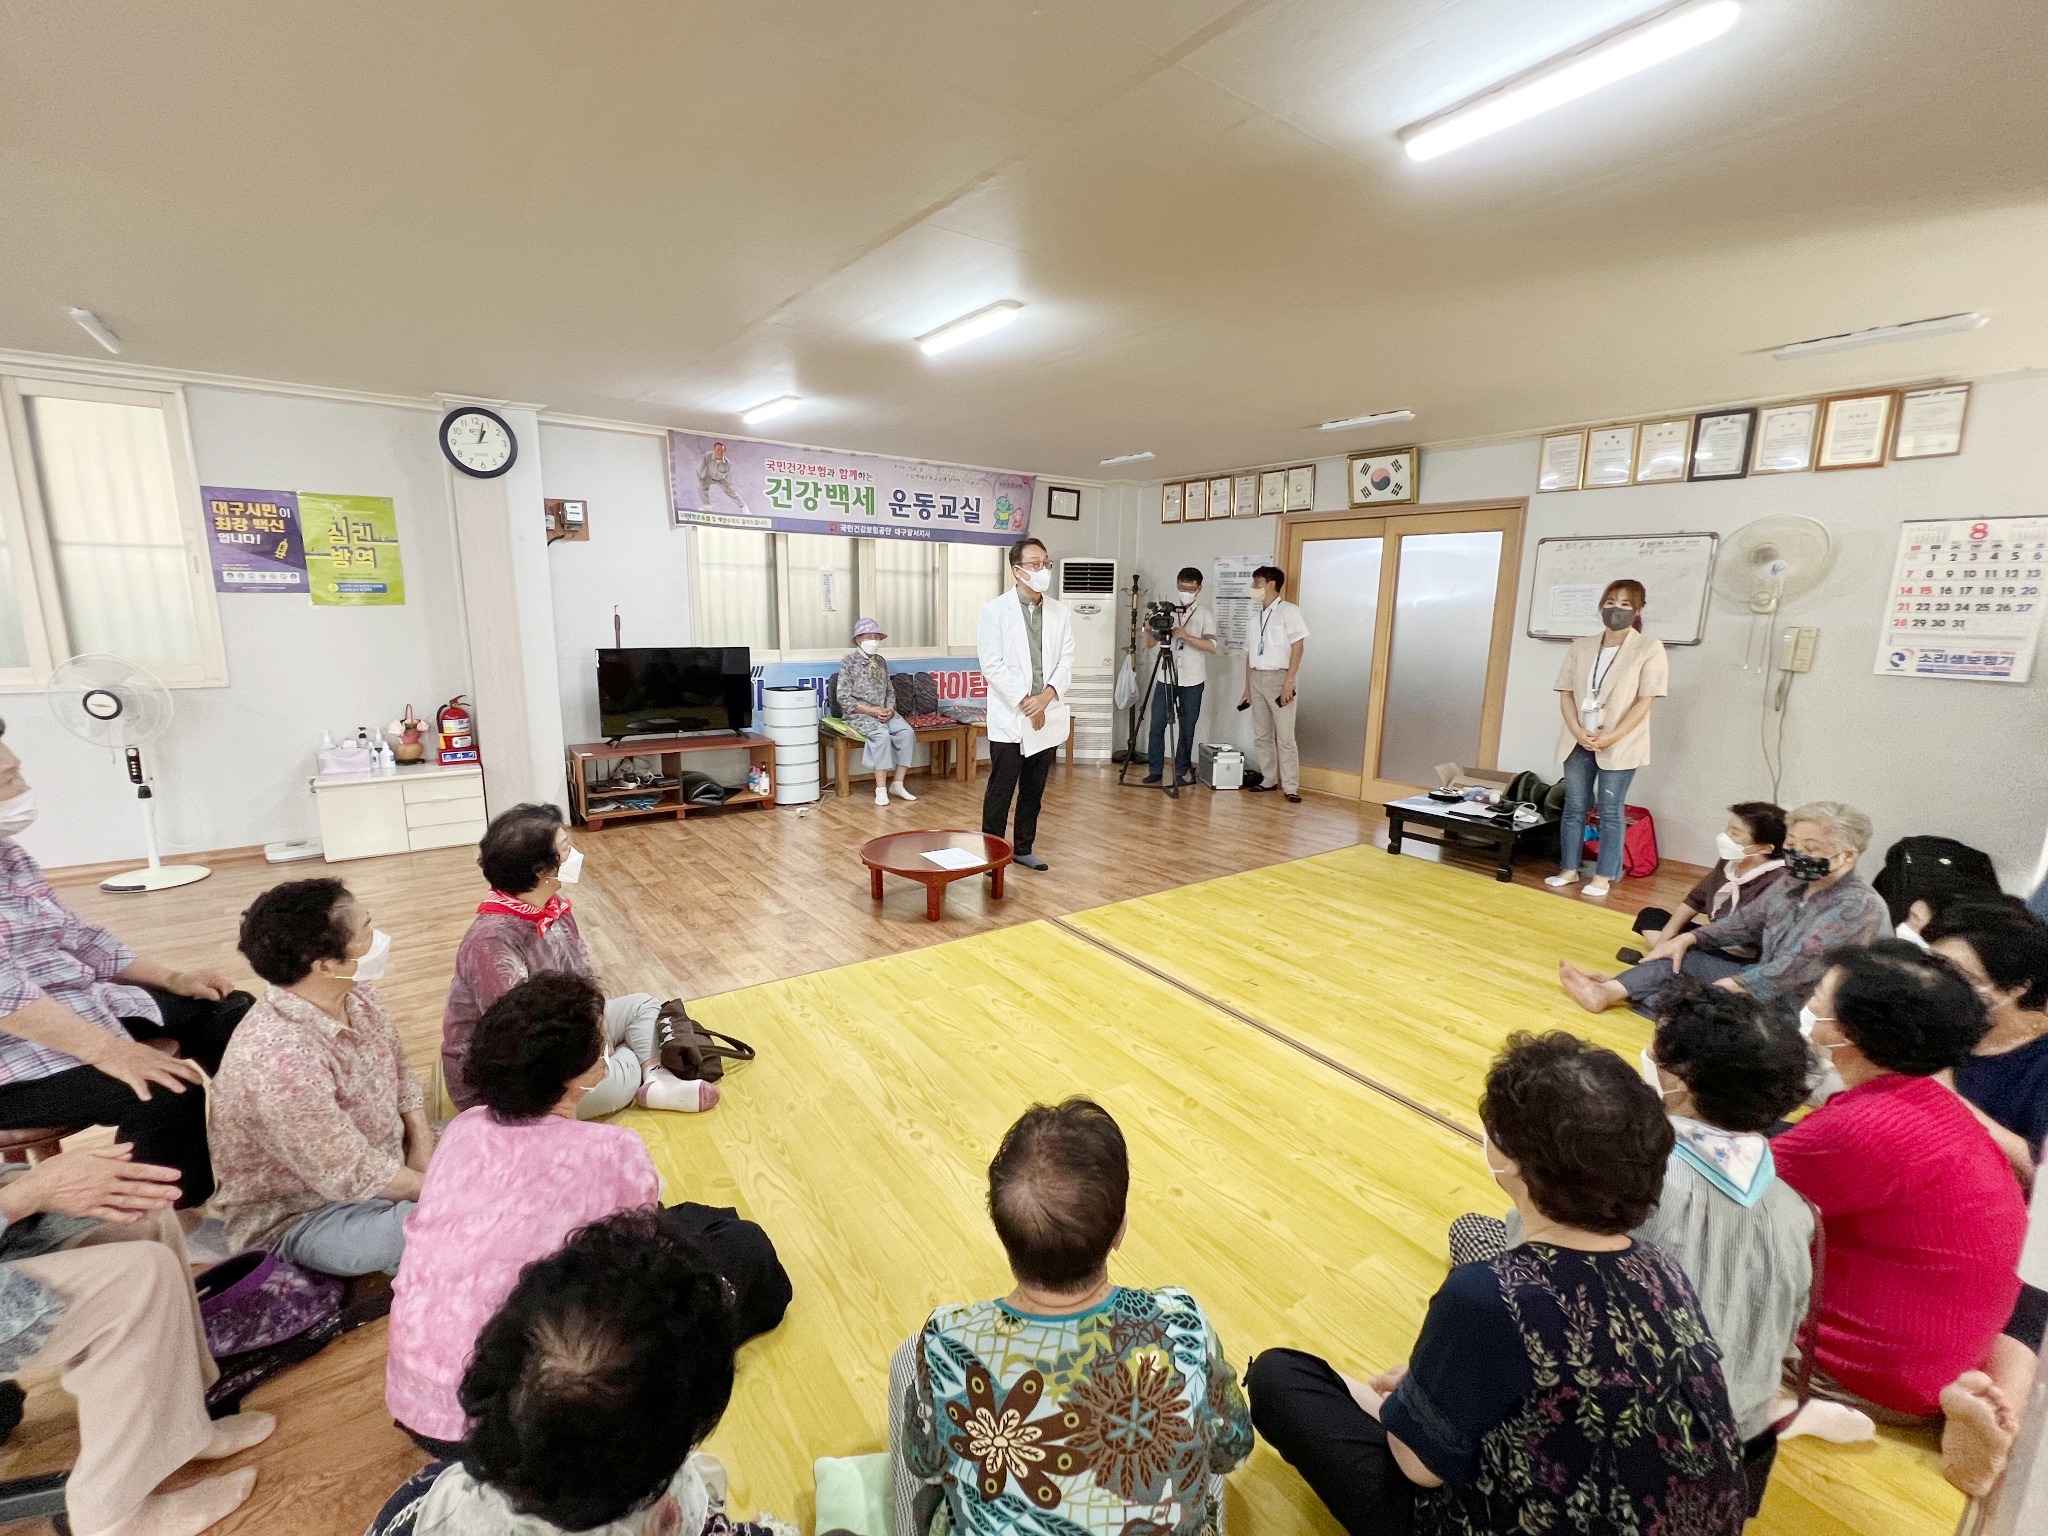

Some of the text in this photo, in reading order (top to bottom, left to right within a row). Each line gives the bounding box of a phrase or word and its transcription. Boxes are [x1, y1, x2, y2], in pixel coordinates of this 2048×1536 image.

[460, 419, 467, 427] 11
[471, 417, 479, 425] 12
[453, 427, 462, 435] 10
[495, 428, 501, 437] 2
[450, 438, 457, 446] 9
[457, 450, 463, 458] 8
[492, 458, 498, 466] 5
[765, 460, 835, 478] 국민건강보험과
[838, 467, 874, 481] 함께하는
[764, 477, 982, 525] 건강백세 운동교실
[211, 501, 291, 518] 대구시민이
[215, 517, 286, 533] 최강 백신
[327, 516, 375, 546] 심리
[840, 524, 892, 536] 국민건강보험공단
[1969, 522, 1989, 540] 8
[217, 532, 261, 545] 입니다!
[330, 546, 377, 569] 방역
[1969, 553, 1978, 561] 3
[2012, 552, 2020, 560] 5
[2033, 551, 2042, 560] 6
[1906, 570, 2041, 578] 7 8 9 10 11 12 13
[1900, 587, 2038, 595] 14 15 16 17 18 19 20
[1898, 603, 2033, 612] 21 22 23 24 25 26 27
[1912, 619, 1927, 628] 29
[1931, 619, 1946, 628] 30
[1952, 619, 1966, 628] 31
